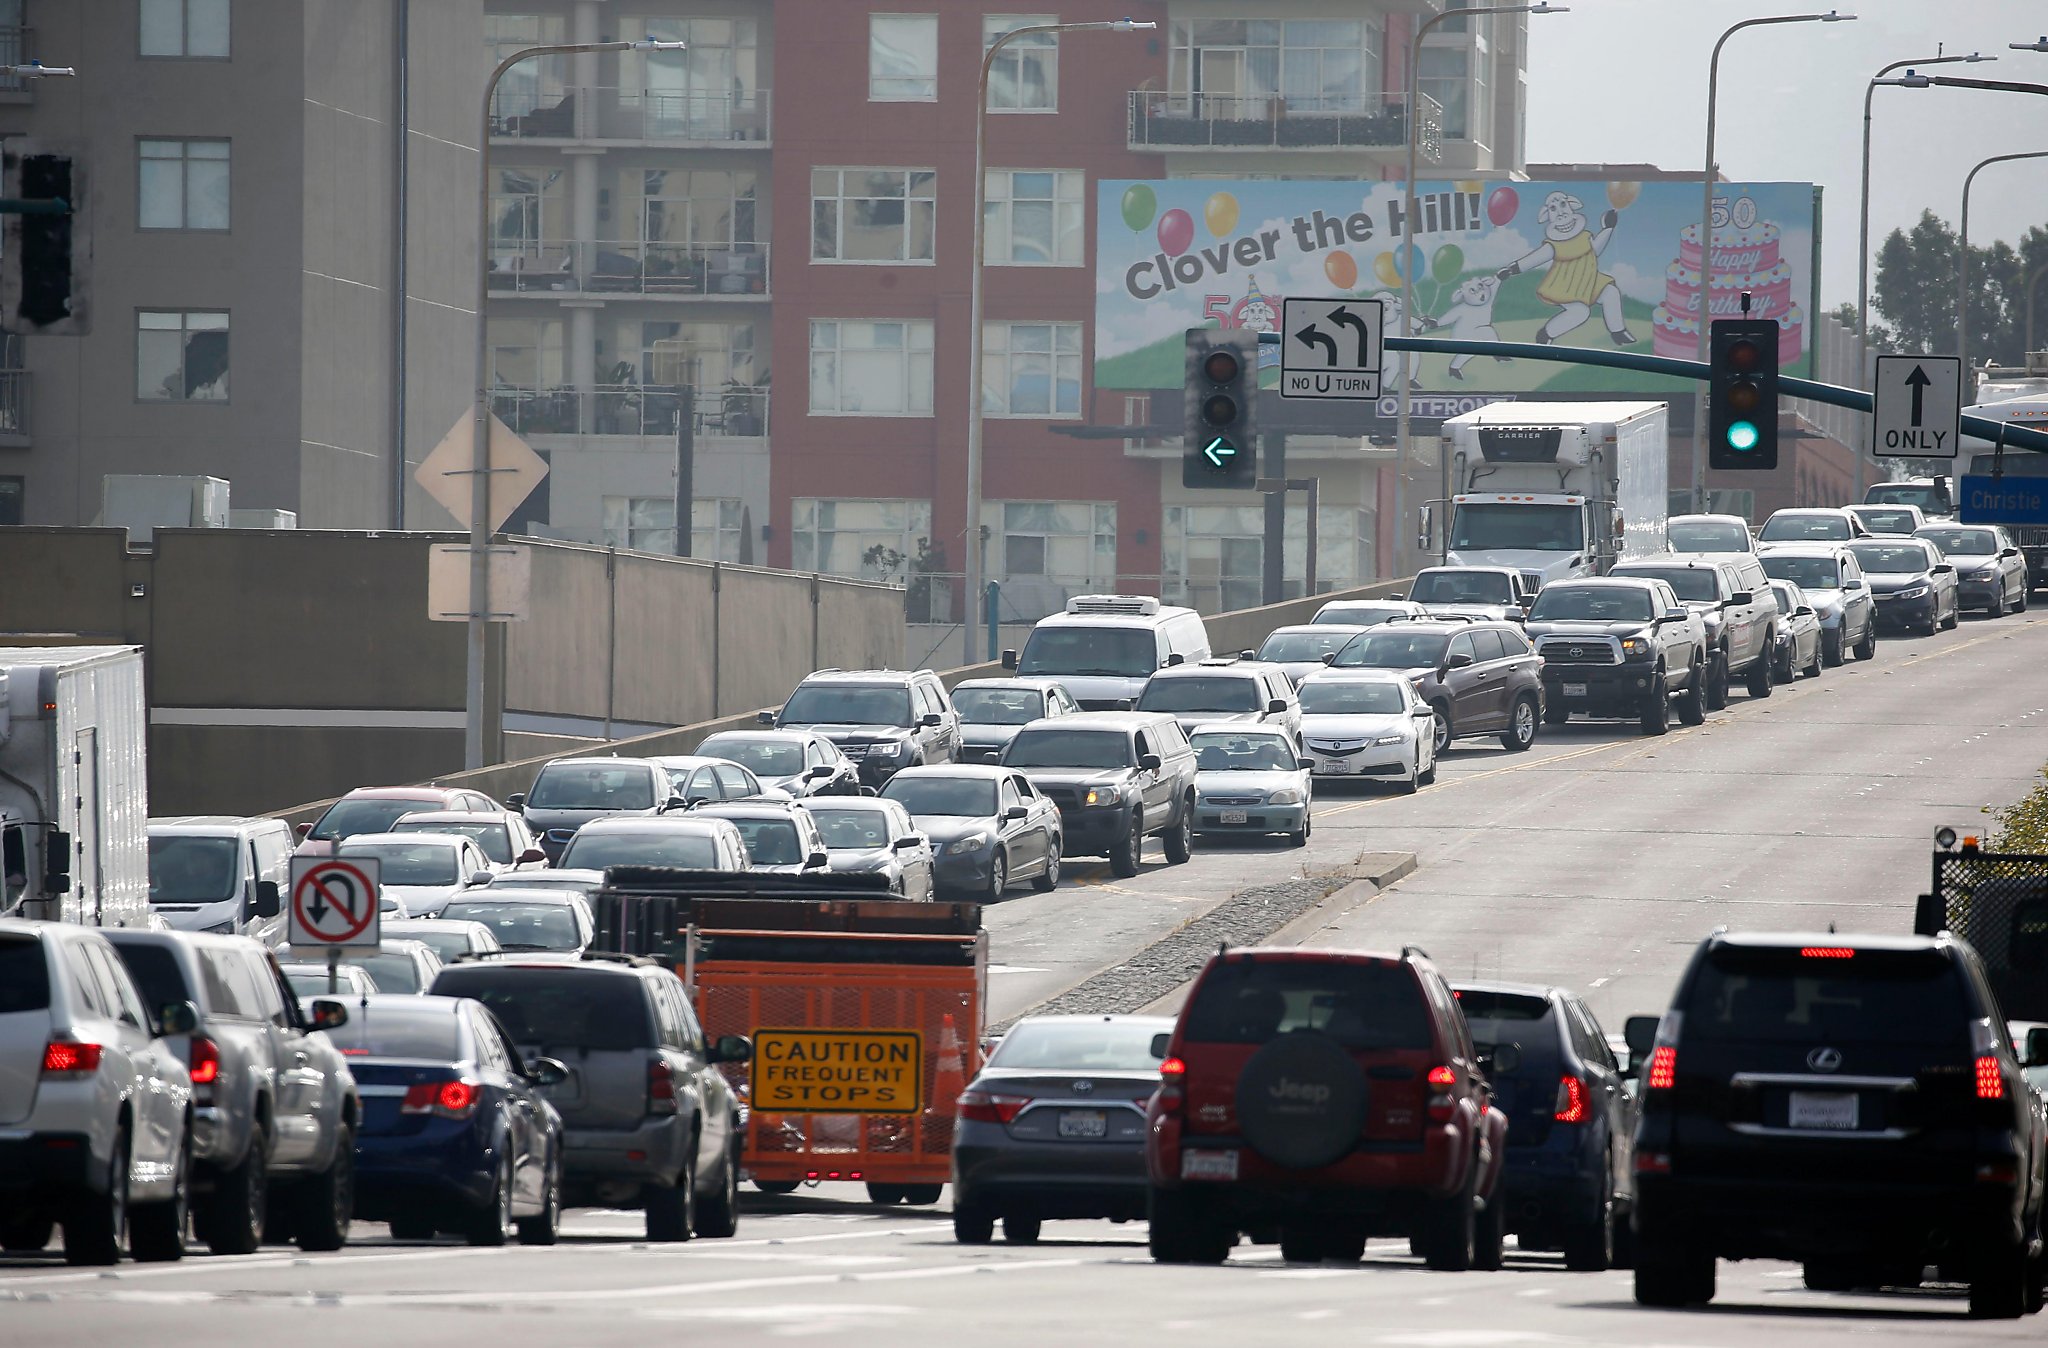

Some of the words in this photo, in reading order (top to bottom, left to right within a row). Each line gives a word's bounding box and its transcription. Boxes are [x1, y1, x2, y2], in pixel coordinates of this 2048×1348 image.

[1711, 197, 1757, 229] 50
[1125, 228, 1281, 300] Clover
[1291, 210, 1374, 253] the
[1387, 191, 1482, 237] Hill!
[1291, 377, 1310, 390] NO
[1315, 374, 1331, 394] U
[1335, 378, 1371, 391] TURN
[1498, 432, 1541, 440] CARRIER
[1885, 429, 1947, 450] ONLY
[1971, 489, 2041, 511] Christie
[764, 1041, 910, 1063] CAUTION
[767, 1065, 905, 1083] FREQUENT
[773, 1085, 897, 1102] STOPS
[1268, 1077, 1331, 1102] Jeep
